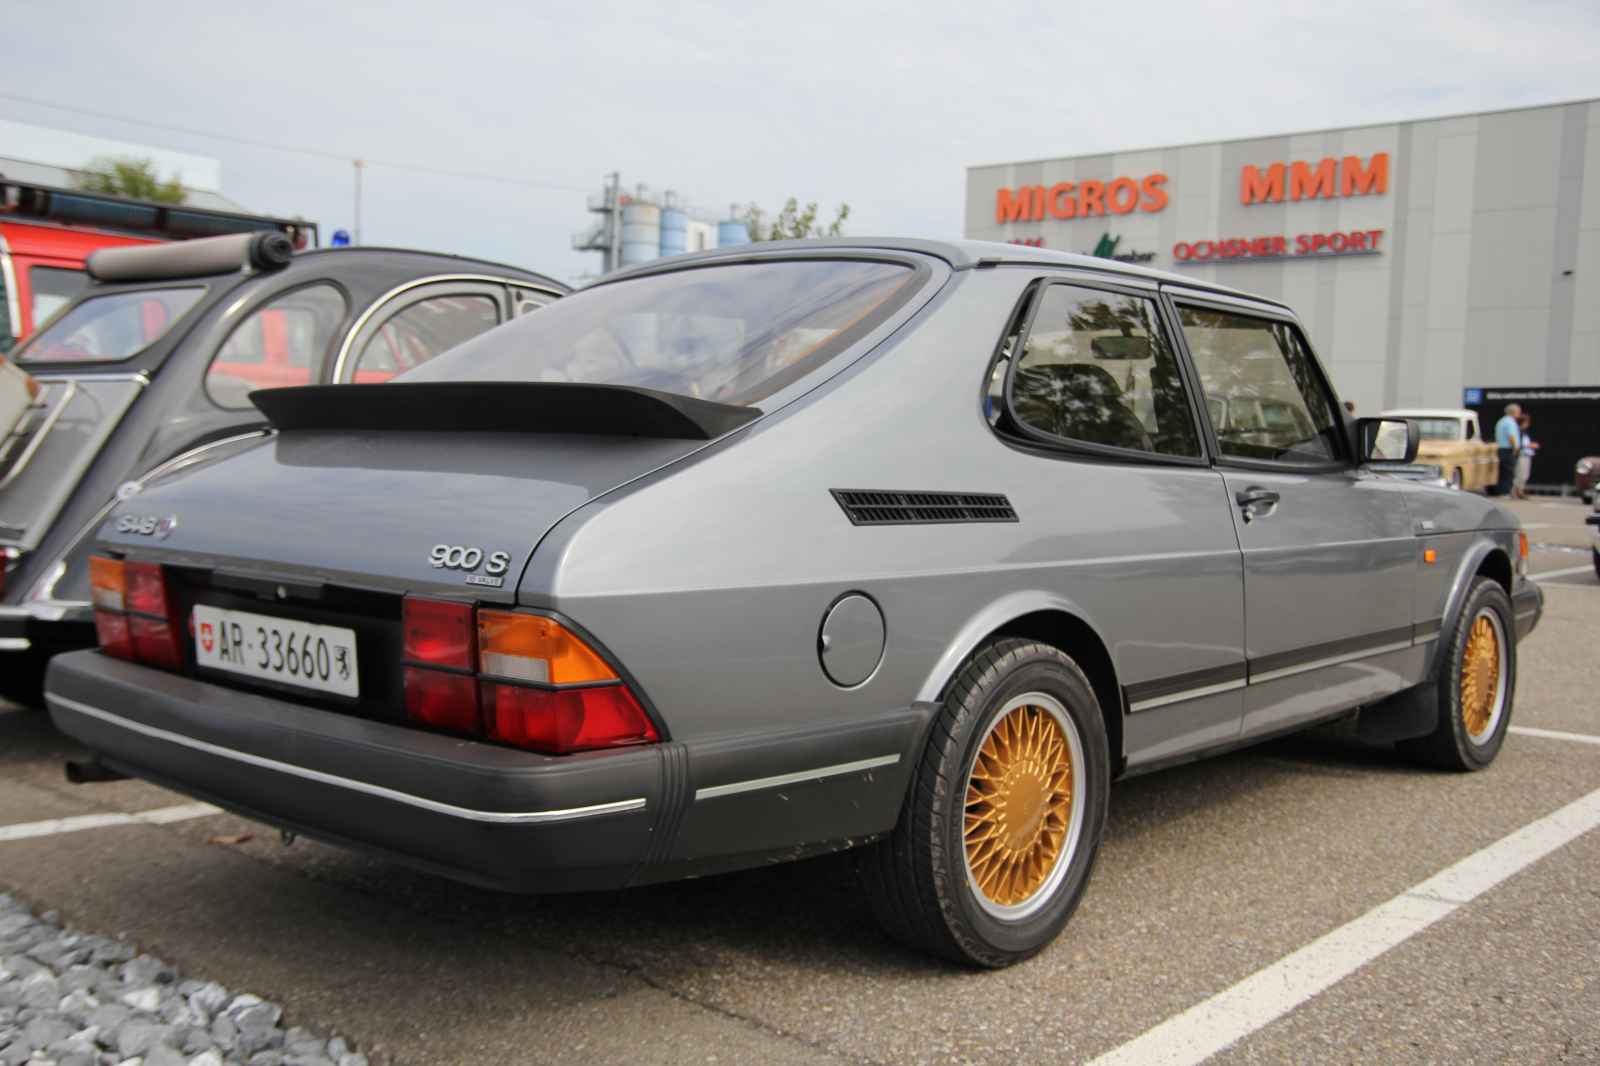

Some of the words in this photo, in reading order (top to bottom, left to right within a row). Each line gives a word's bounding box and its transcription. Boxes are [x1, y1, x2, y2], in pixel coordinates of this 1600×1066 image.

[996, 174, 1169, 223] MIGROS
[1240, 153, 1389, 205] MMM
[1173, 236, 1287, 261] OCHSNER
[1295, 230, 1384, 254] SPORT
[117, 514, 158, 535] SAAB
[428, 544, 484, 572] 900
[485, 551, 511, 576] S
[477, 576, 501, 586] VALVE
